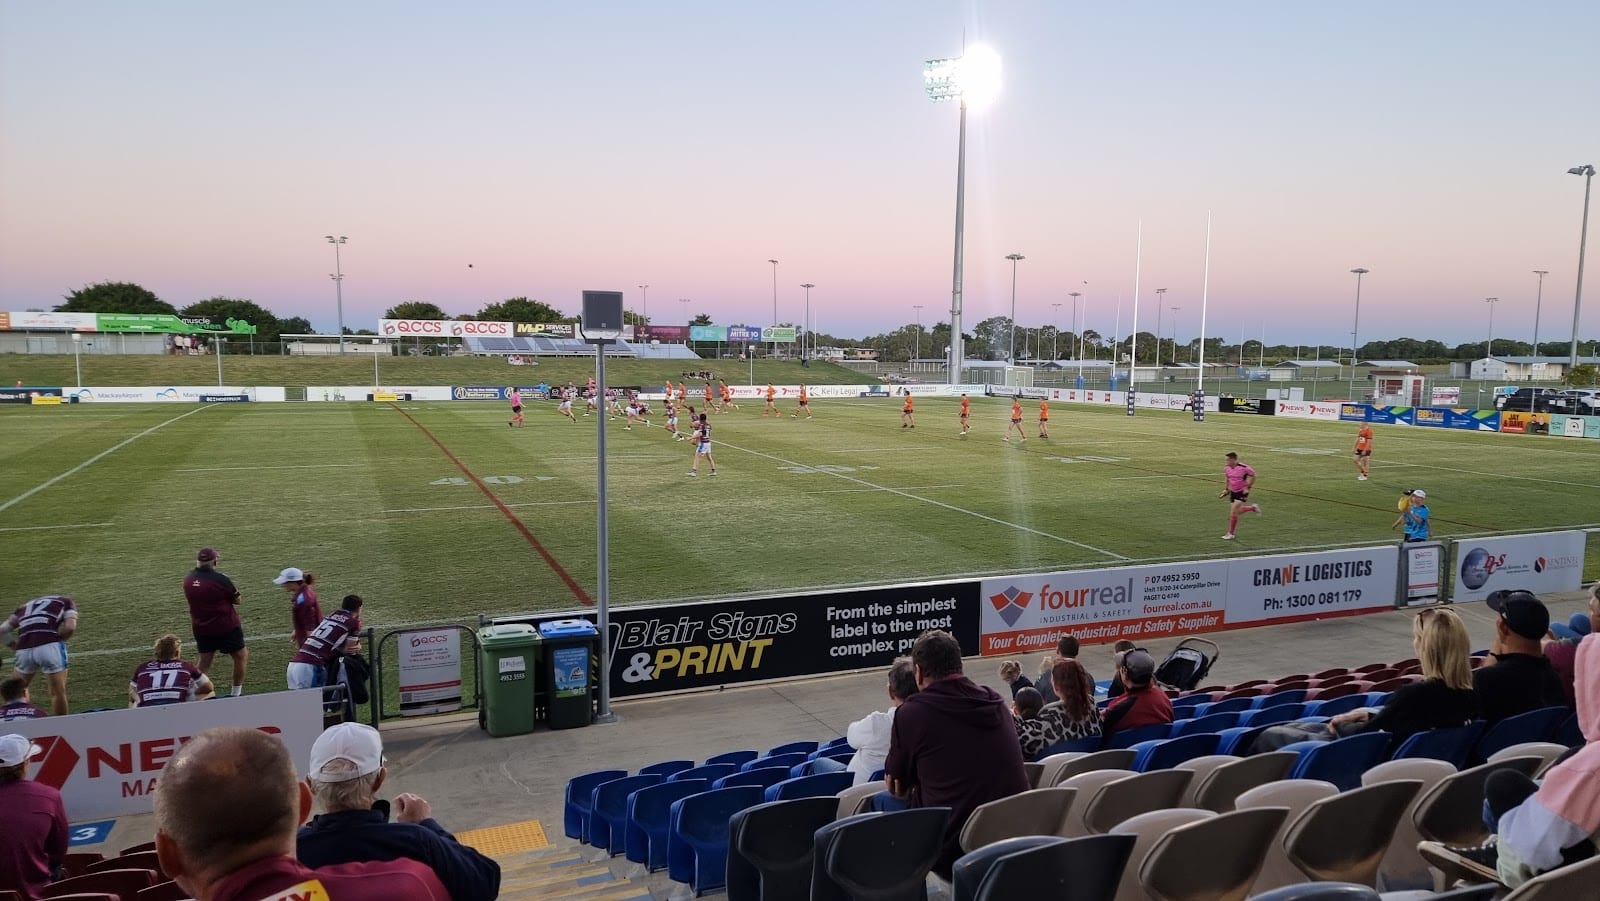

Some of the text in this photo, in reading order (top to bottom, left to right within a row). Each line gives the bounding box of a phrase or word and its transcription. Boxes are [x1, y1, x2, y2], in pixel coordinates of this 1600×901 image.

[397, 321, 441, 333] QCCS
[465, 322, 507, 334] QCCS
[1151, 575, 1161, 584] 07
[1161, 574, 1181, 583] 4952
[1181, 572, 1200, 581] 5950
[1253, 559, 1373, 587] CRANE LOGISTICS
[1039, 577, 1134, 611] fourreal
[1263, 589, 1363, 611] Ph: 1300 081 179
[24, 598, 52, 616] 12
[826, 597, 957, 621] From the simplest
[1040, 612, 1090, 624] INDUSTRIAL
[1102, 608, 1131, 618] SAFETY
[1143, 600, 1212, 614] fourreal.com.au
[618, 612, 798, 650] Blair Signs
[831, 614, 952, 639] label to the most
[988, 636, 1014, 650] Your
[1122, 621, 1142, 635] and
[1144, 618, 1176, 633] Safety
[1177, 614, 1220, 631] Supplier
[420, 634, 448, 644] QCCS
[829, 638, 895, 657] complex
[149, 669, 178, 690] 17
[71, 827, 97, 841] 3
